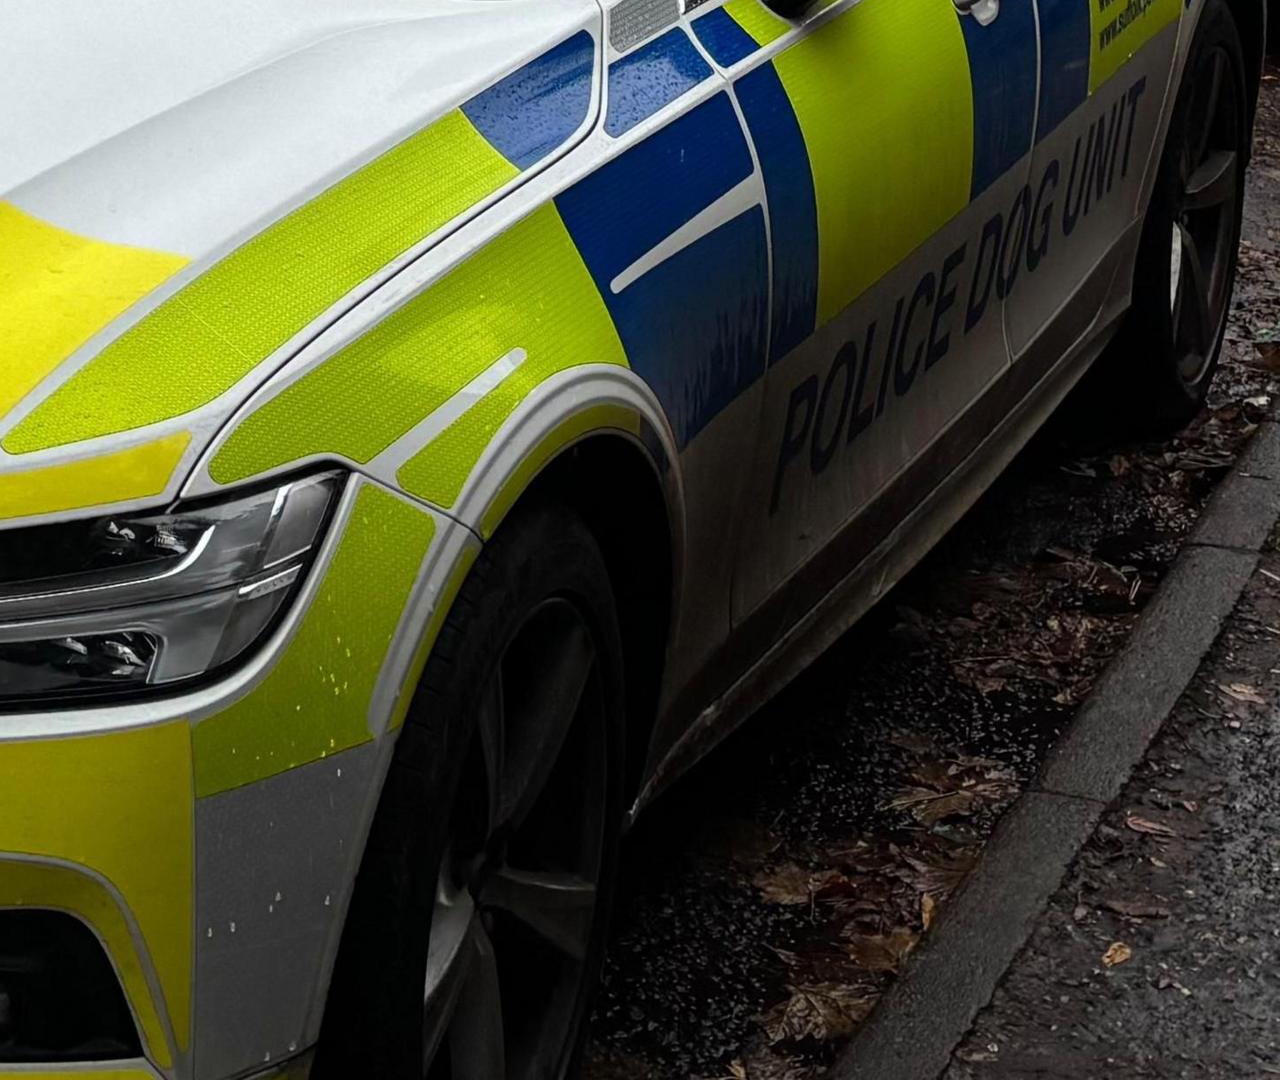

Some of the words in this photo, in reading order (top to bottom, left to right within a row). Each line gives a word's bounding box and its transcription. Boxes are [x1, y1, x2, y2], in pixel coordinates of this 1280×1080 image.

[770, 241, 967, 517] POLICE
[963, 159, 1060, 335] DOG
[1062, 76, 1147, 236] UNIT
